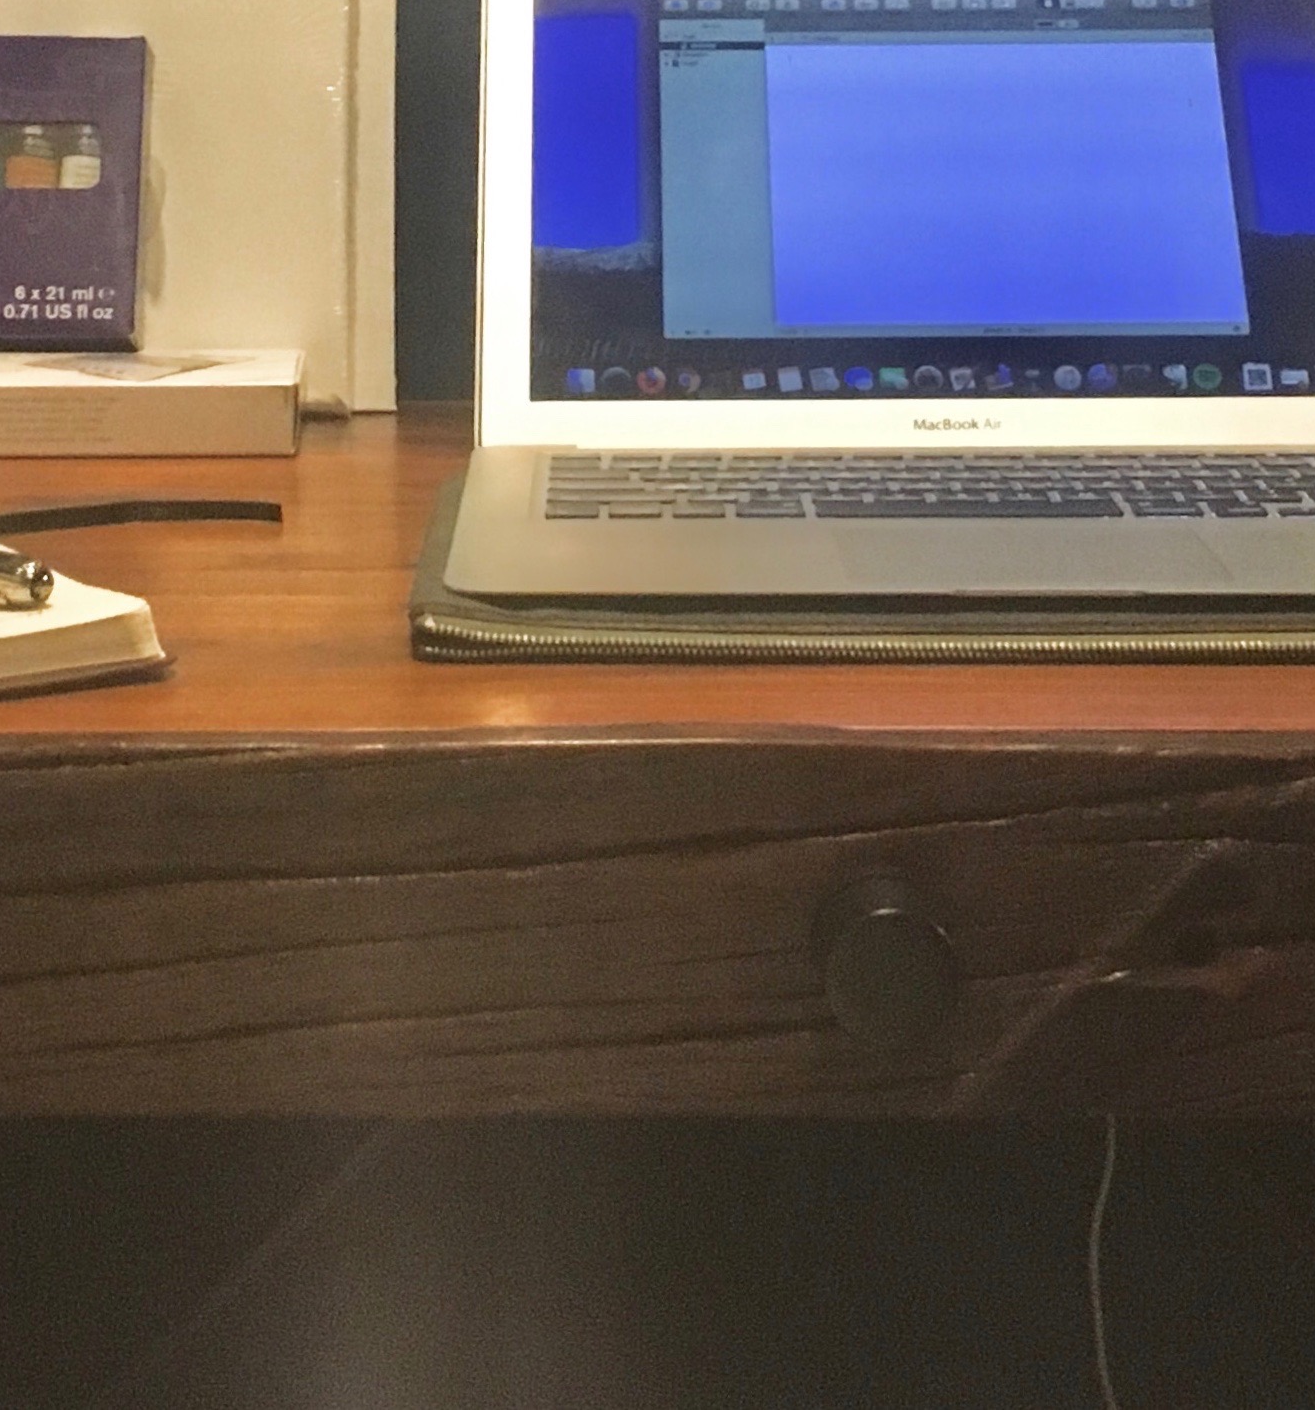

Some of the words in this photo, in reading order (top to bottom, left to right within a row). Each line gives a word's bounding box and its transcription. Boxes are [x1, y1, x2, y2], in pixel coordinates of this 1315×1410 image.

[14, 285, 26, 301] 6
[30, 289, 41, 300] x
[45, 285, 66, 300] 21
[72, 285, 95, 301] ml
[3, 303, 39, 319] 0.71
[45, 303, 72, 319] US
[76, 303, 89, 319] fl
[92, 306, 115, 319] oz
[913, 418, 979, 430] MacBook
[983, 418, 1002, 430] Air
